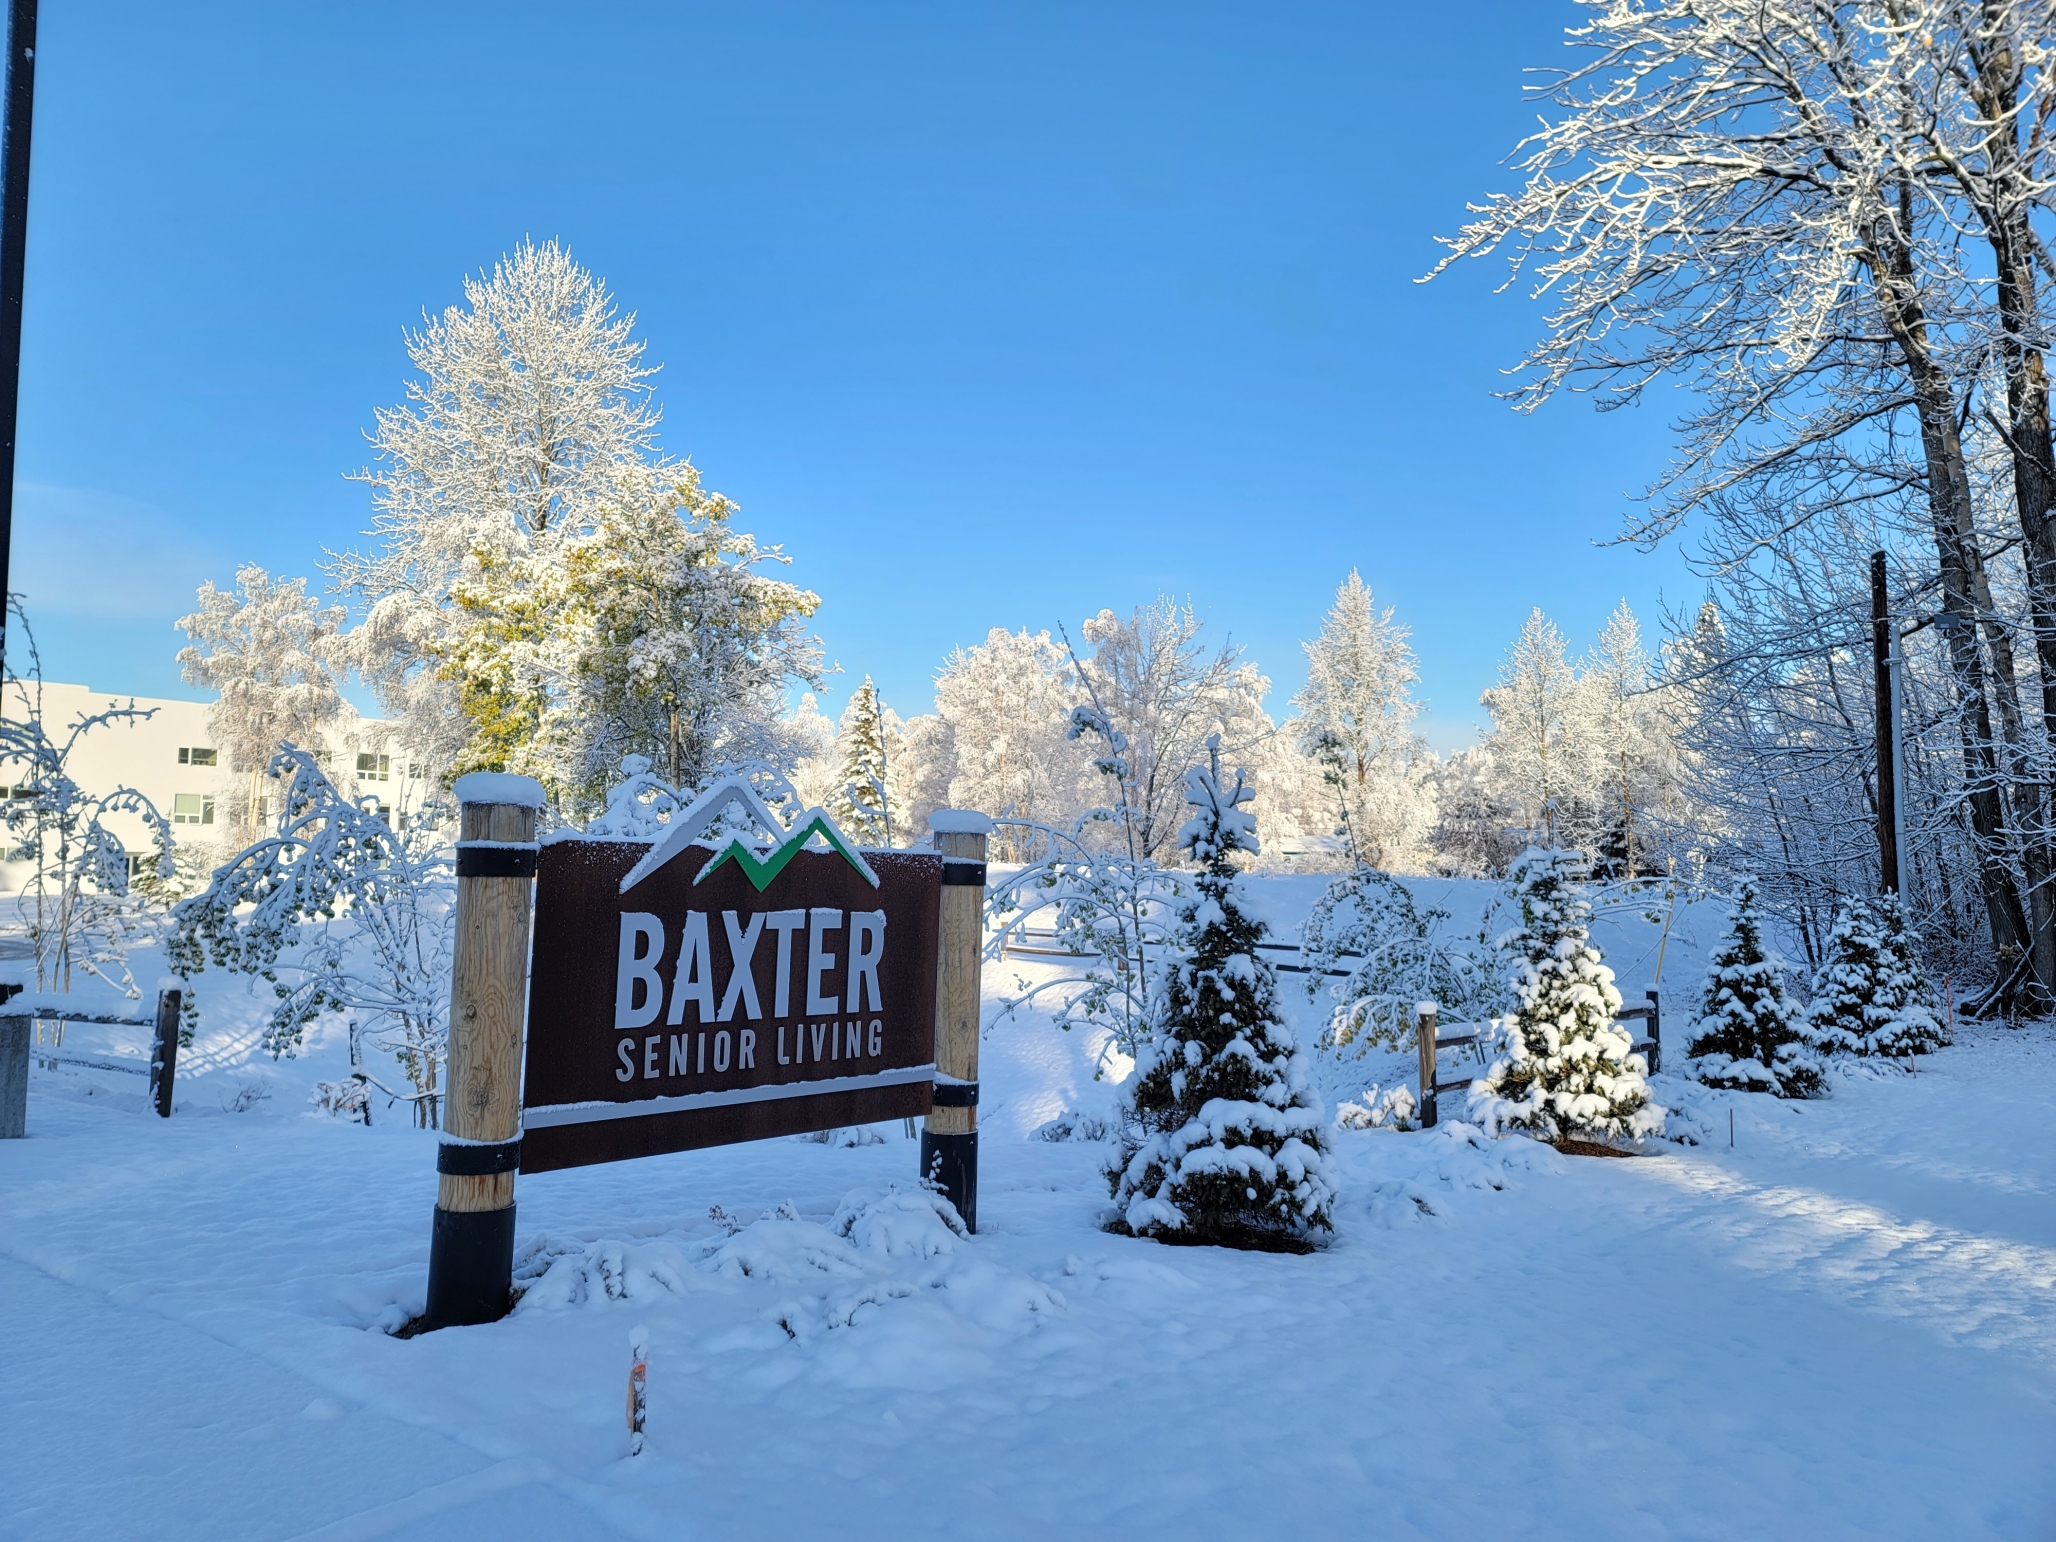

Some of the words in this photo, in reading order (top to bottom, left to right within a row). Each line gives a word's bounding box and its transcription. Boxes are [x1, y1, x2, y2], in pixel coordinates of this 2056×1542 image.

[614, 907, 886, 1029] BAXTER
[615, 1029, 755, 1082] SENIOR
[777, 1019, 882, 1065] LIVING
